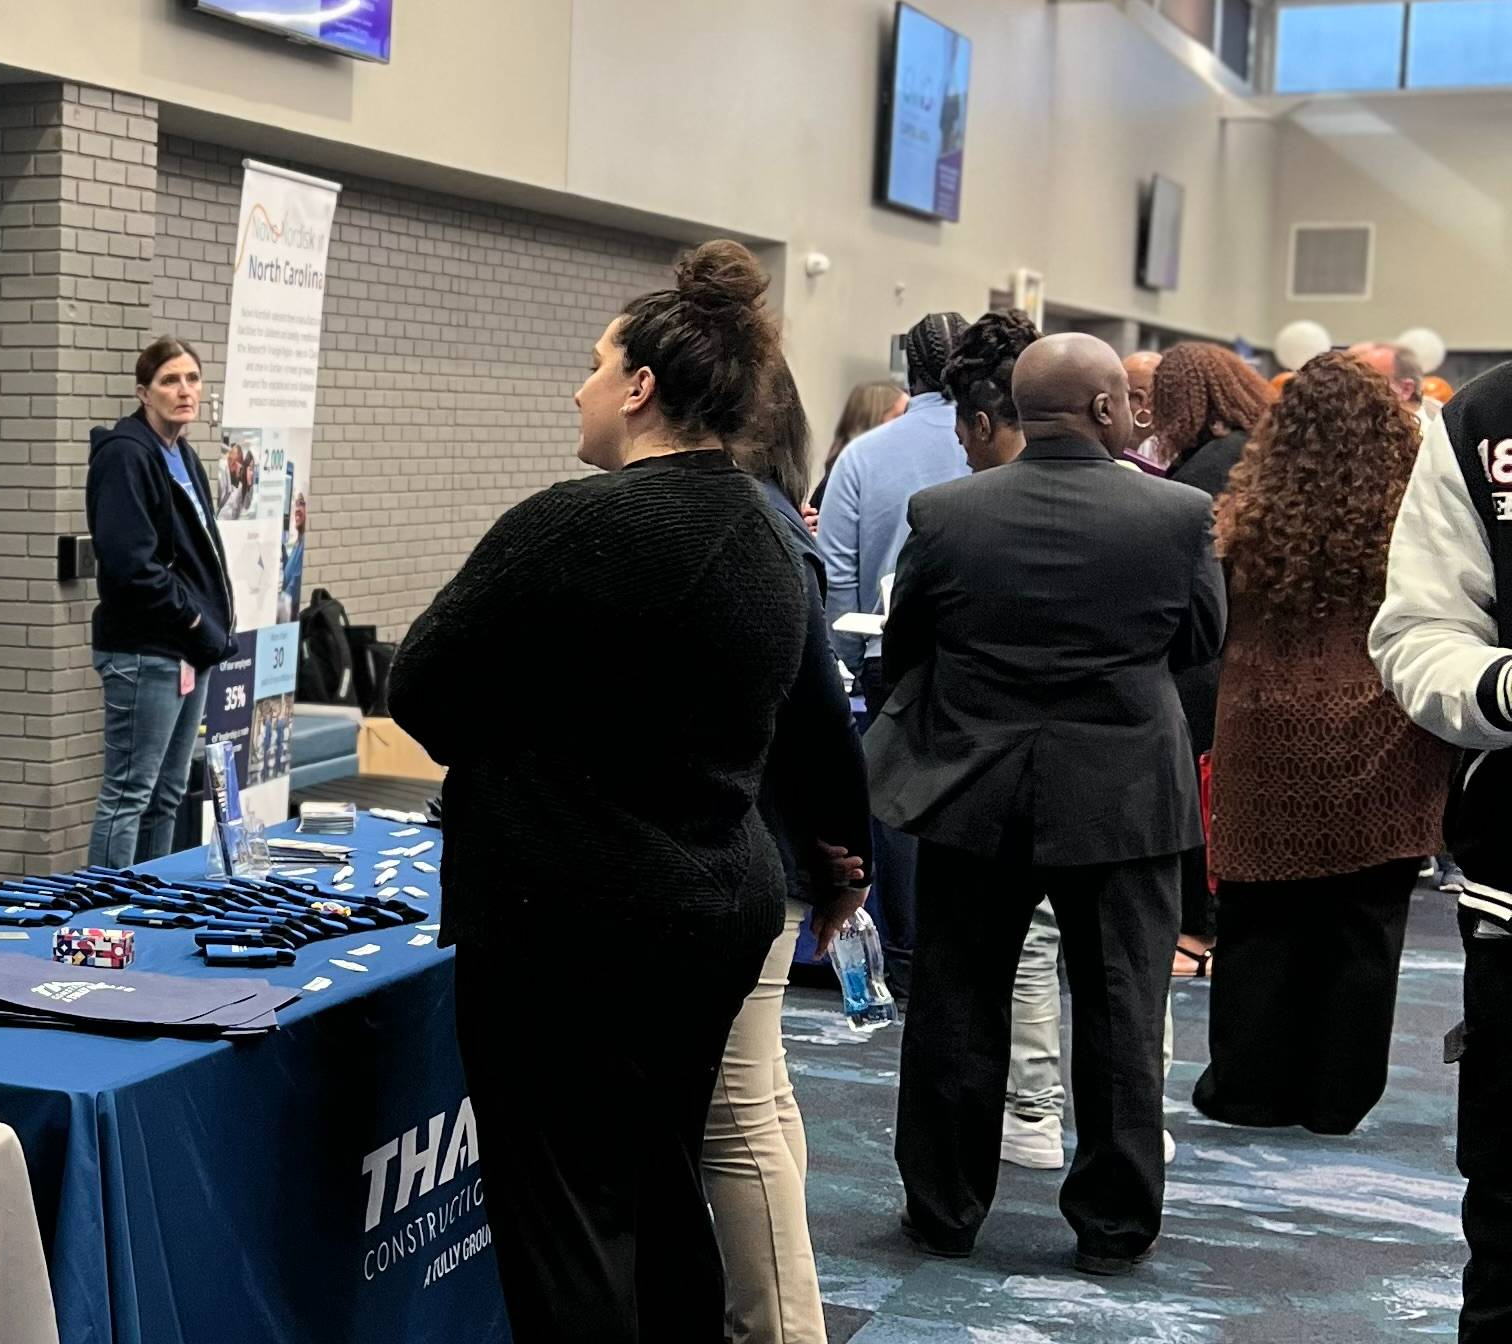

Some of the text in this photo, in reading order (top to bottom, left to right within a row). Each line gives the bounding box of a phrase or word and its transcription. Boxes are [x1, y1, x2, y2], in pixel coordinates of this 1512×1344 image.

[248, 254, 324, 291] North Carolina
[272, 645, 285, 669] 30
[224, 684, 247, 712] 35%
[361, 1095, 480, 1233] THA
[423, 1264, 432, 1289] A
[432, 1241, 461, 1282] TULLY
